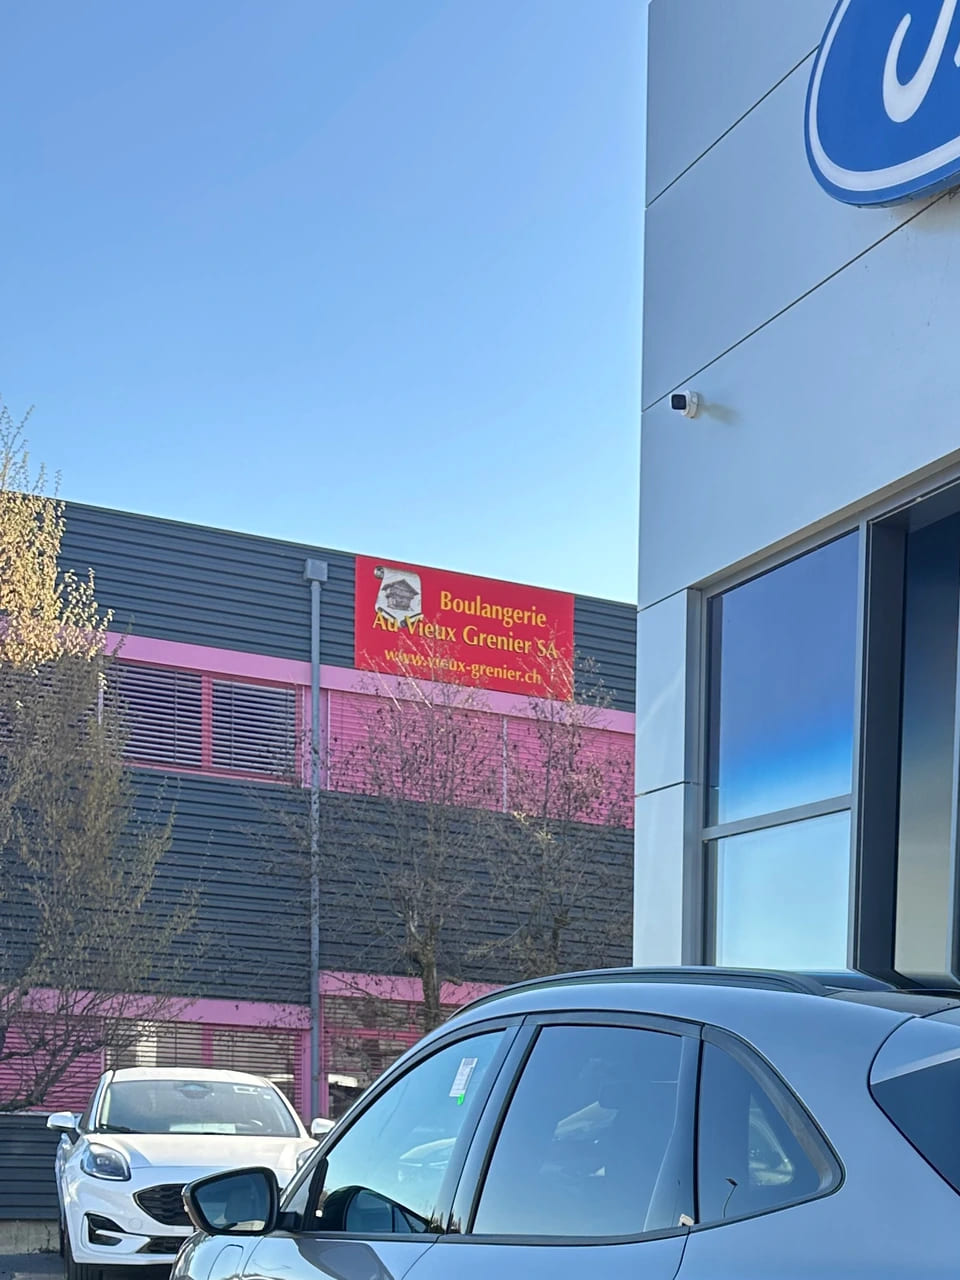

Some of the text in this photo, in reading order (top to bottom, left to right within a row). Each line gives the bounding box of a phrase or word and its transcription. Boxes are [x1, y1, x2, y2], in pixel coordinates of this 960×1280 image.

[440, 590, 547, 628] Boulangerie
[372, 611, 558, 659] Au Vieux Grenier SA
[384, 648, 542, 685] www.vieux-grenier.ch
